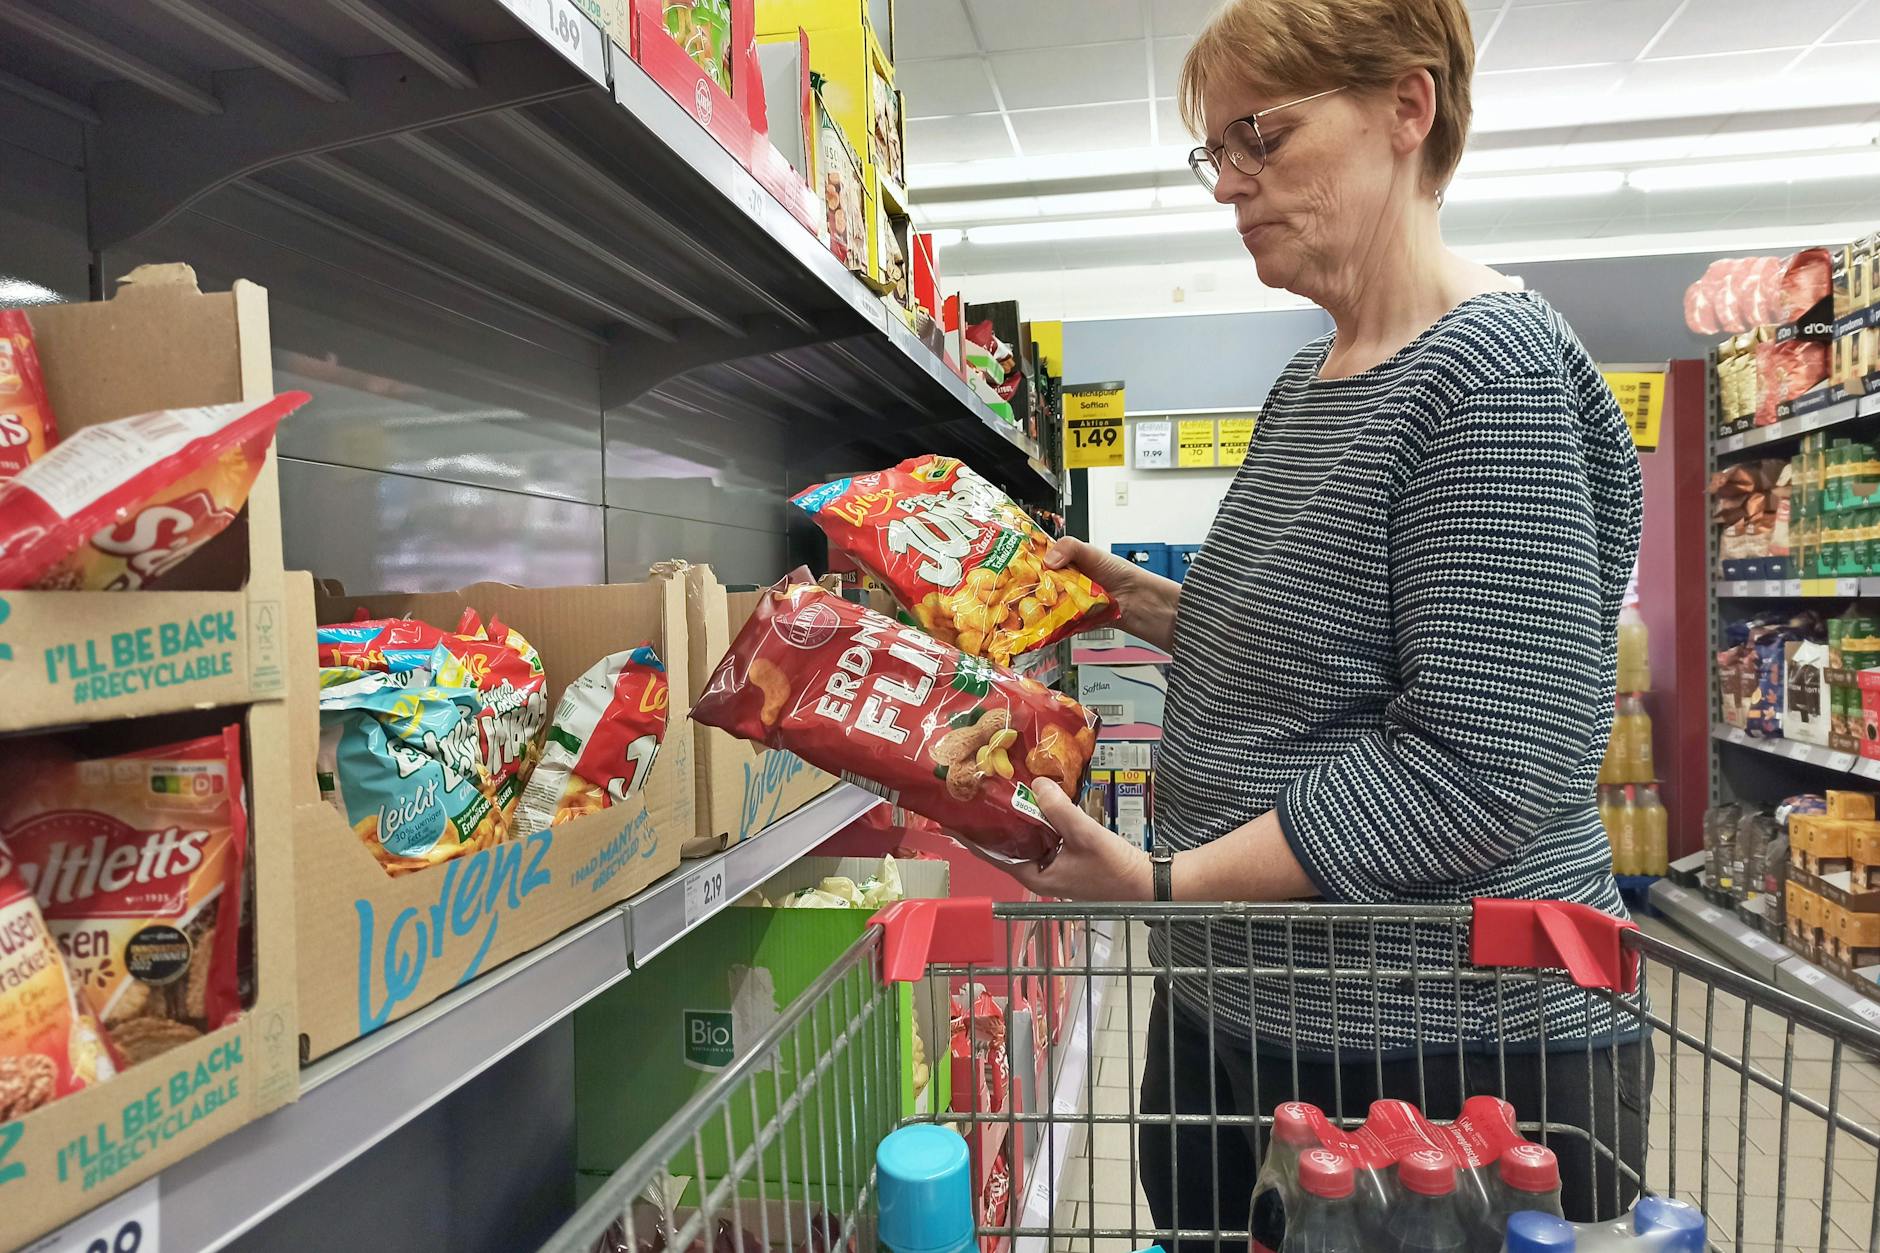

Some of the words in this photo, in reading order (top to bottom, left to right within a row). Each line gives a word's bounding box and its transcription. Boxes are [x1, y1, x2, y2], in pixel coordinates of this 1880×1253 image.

[1080, 401, 1109, 409] Softlan
[1073, 427, 1117, 448] 1.49
[1080, 419, 1109, 427] Aktion
[45, 639, 107, 684] I'LL
[111, 626, 156, 669] BE
[160, 610, 237, 659] BACK
[73, 652, 234, 704] #RECYCLABLE
[1082, 682, 1111, 696] Softlan
[1119, 784, 1143, 795] Sunil
[1122, 772, 1140, 780] 100
[376, 778, 439, 844] Leicht
[703, 873, 722, 905] 2.19
[358, 833, 554, 1027] Lorenz
[692, 1019, 730, 1046] Bio
[57, 1122, 118, 1183] I'LL
[122, 1087, 164, 1137] BE
[168, 1036, 244, 1107] BACK
[82, 1076, 240, 1191] #RECYCLABLE
